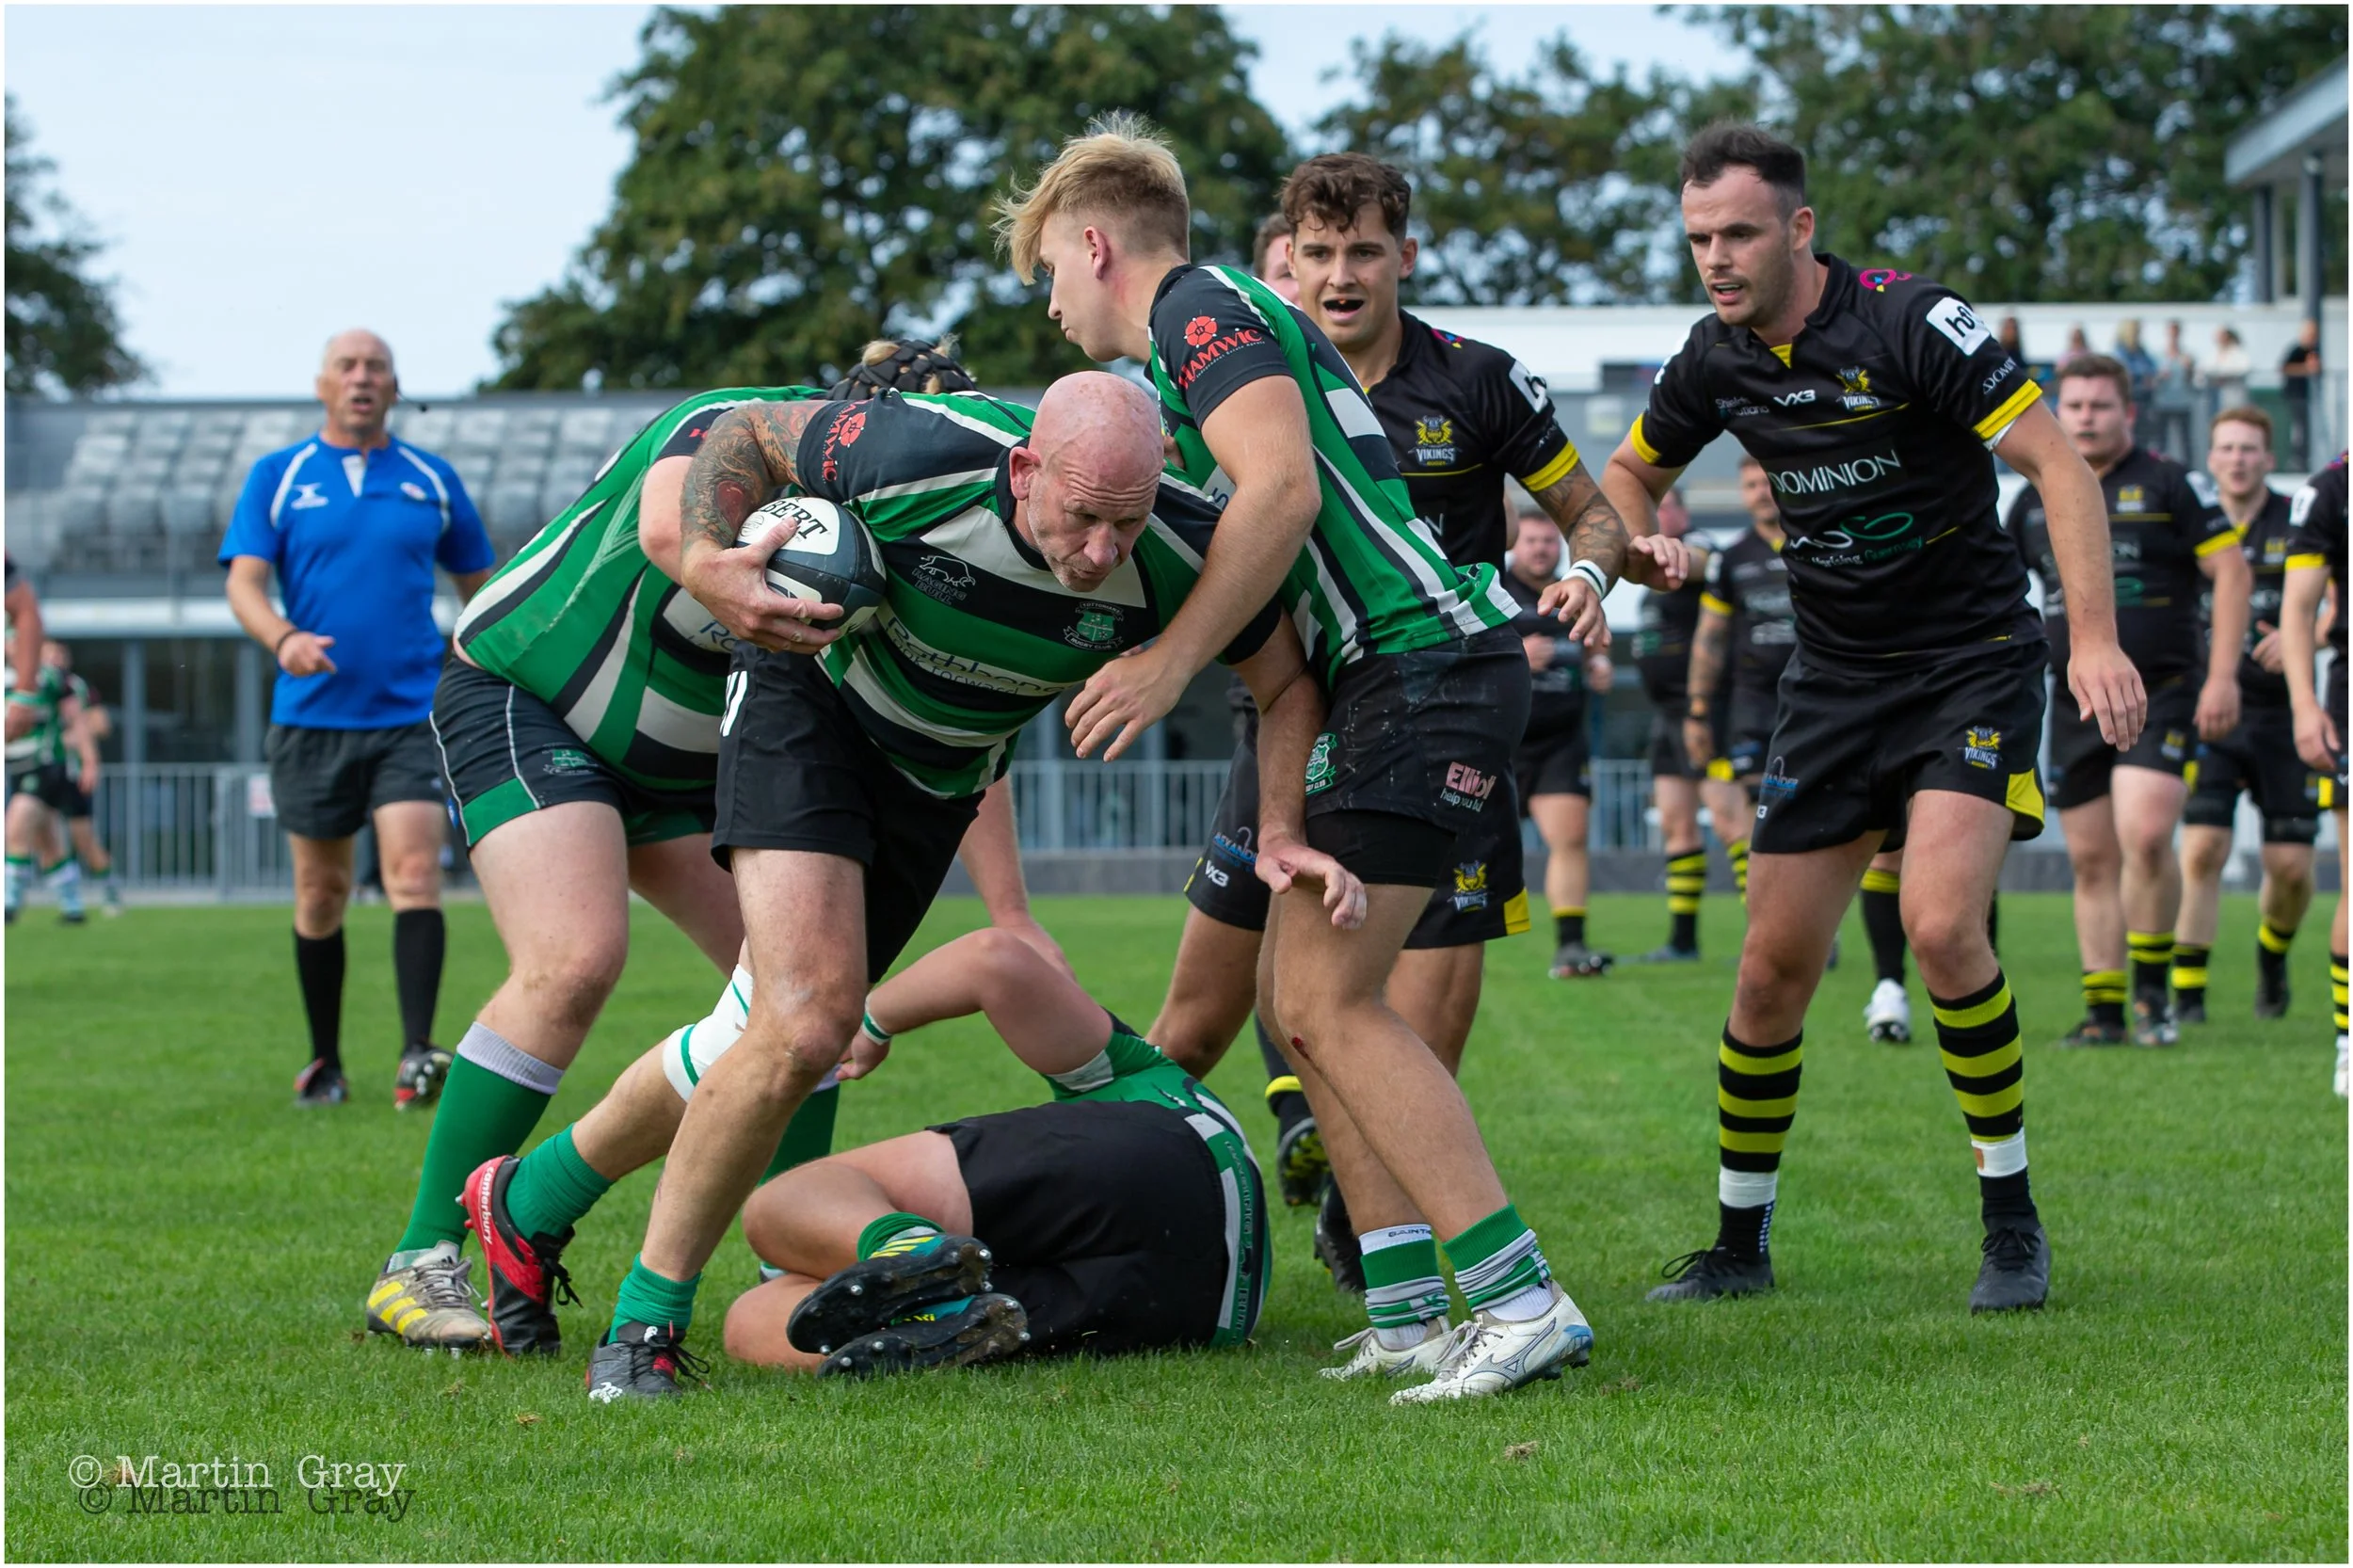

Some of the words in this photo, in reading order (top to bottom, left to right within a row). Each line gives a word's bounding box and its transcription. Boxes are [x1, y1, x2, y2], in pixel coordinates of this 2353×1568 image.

[1773, 389, 1816, 407] VX3
[1416, 447, 1455, 462] VIKINGS
[1965, 746, 1997, 768] VIKINGS
[1440, 788, 1461, 807] help
[481, 1166, 494, 1244] canterbury
